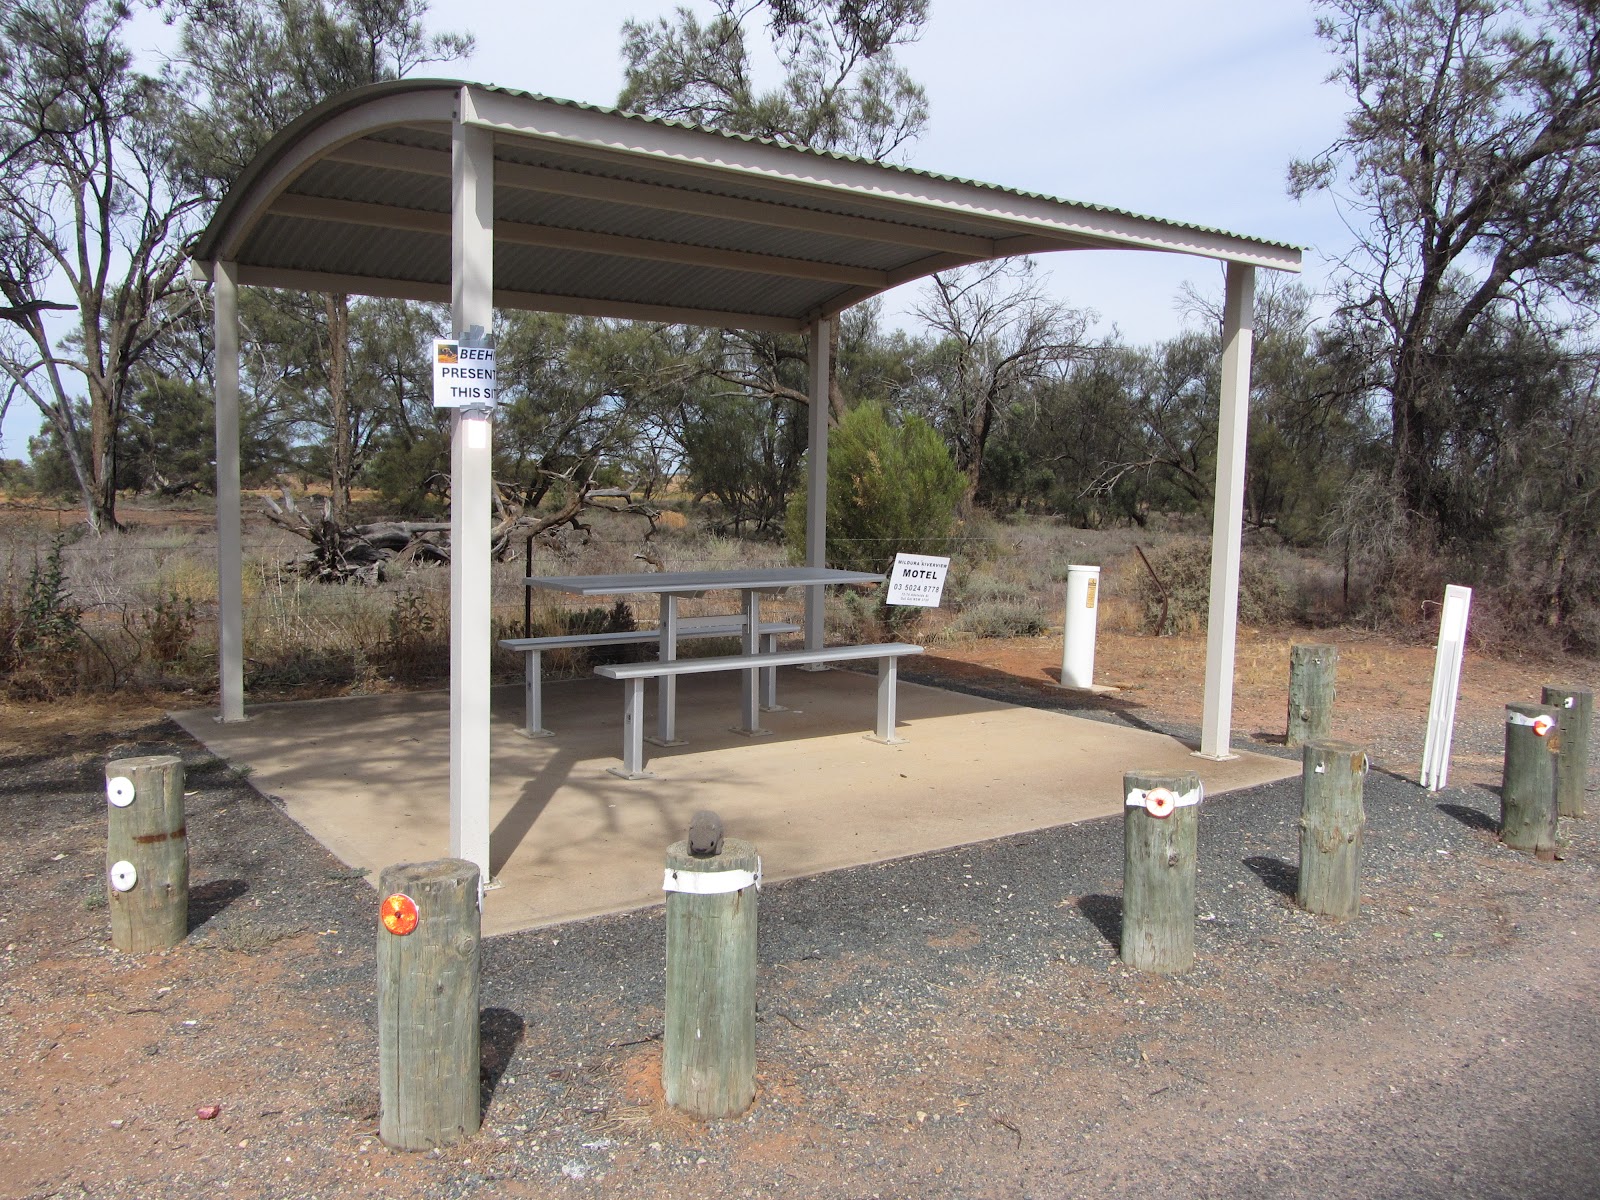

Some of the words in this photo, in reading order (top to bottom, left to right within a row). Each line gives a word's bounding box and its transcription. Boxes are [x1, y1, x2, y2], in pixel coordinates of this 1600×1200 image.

[450, 386, 480, 398] THIS
[902, 569, 937, 580] MOTEL
[893, 583, 903, 591] 03
[905, 584, 921, 592] 5024
